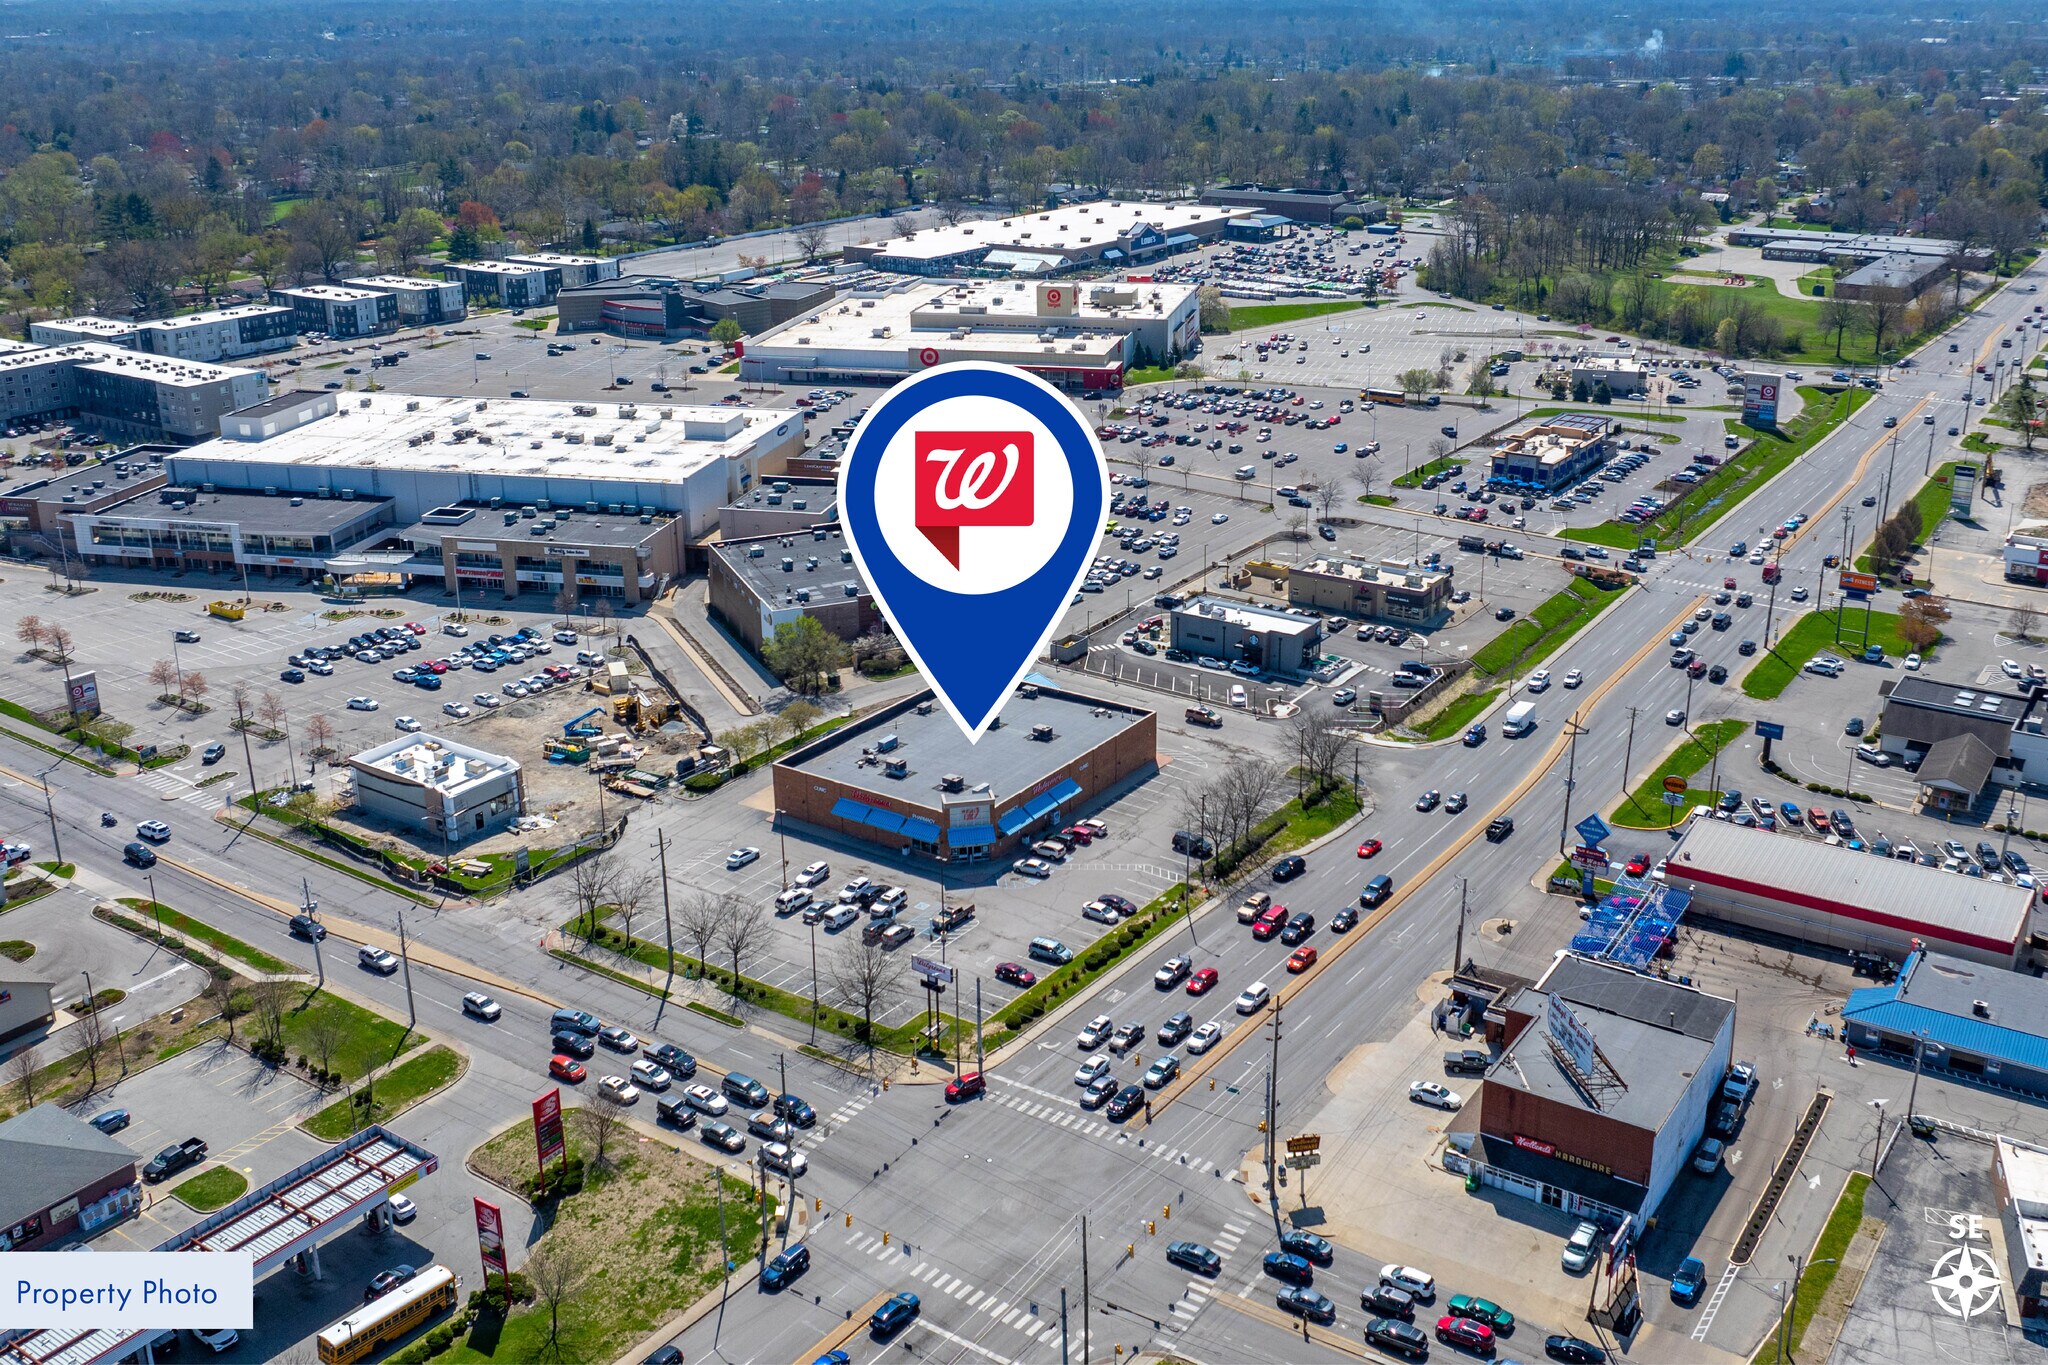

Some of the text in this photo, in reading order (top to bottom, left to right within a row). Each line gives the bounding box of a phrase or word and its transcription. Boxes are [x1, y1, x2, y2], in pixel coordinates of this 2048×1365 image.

[1572, 854, 1585, 862] Car
[1587, 857, 1606, 867] Wash
[1555, 1150, 1612, 1175] HARDWARE
